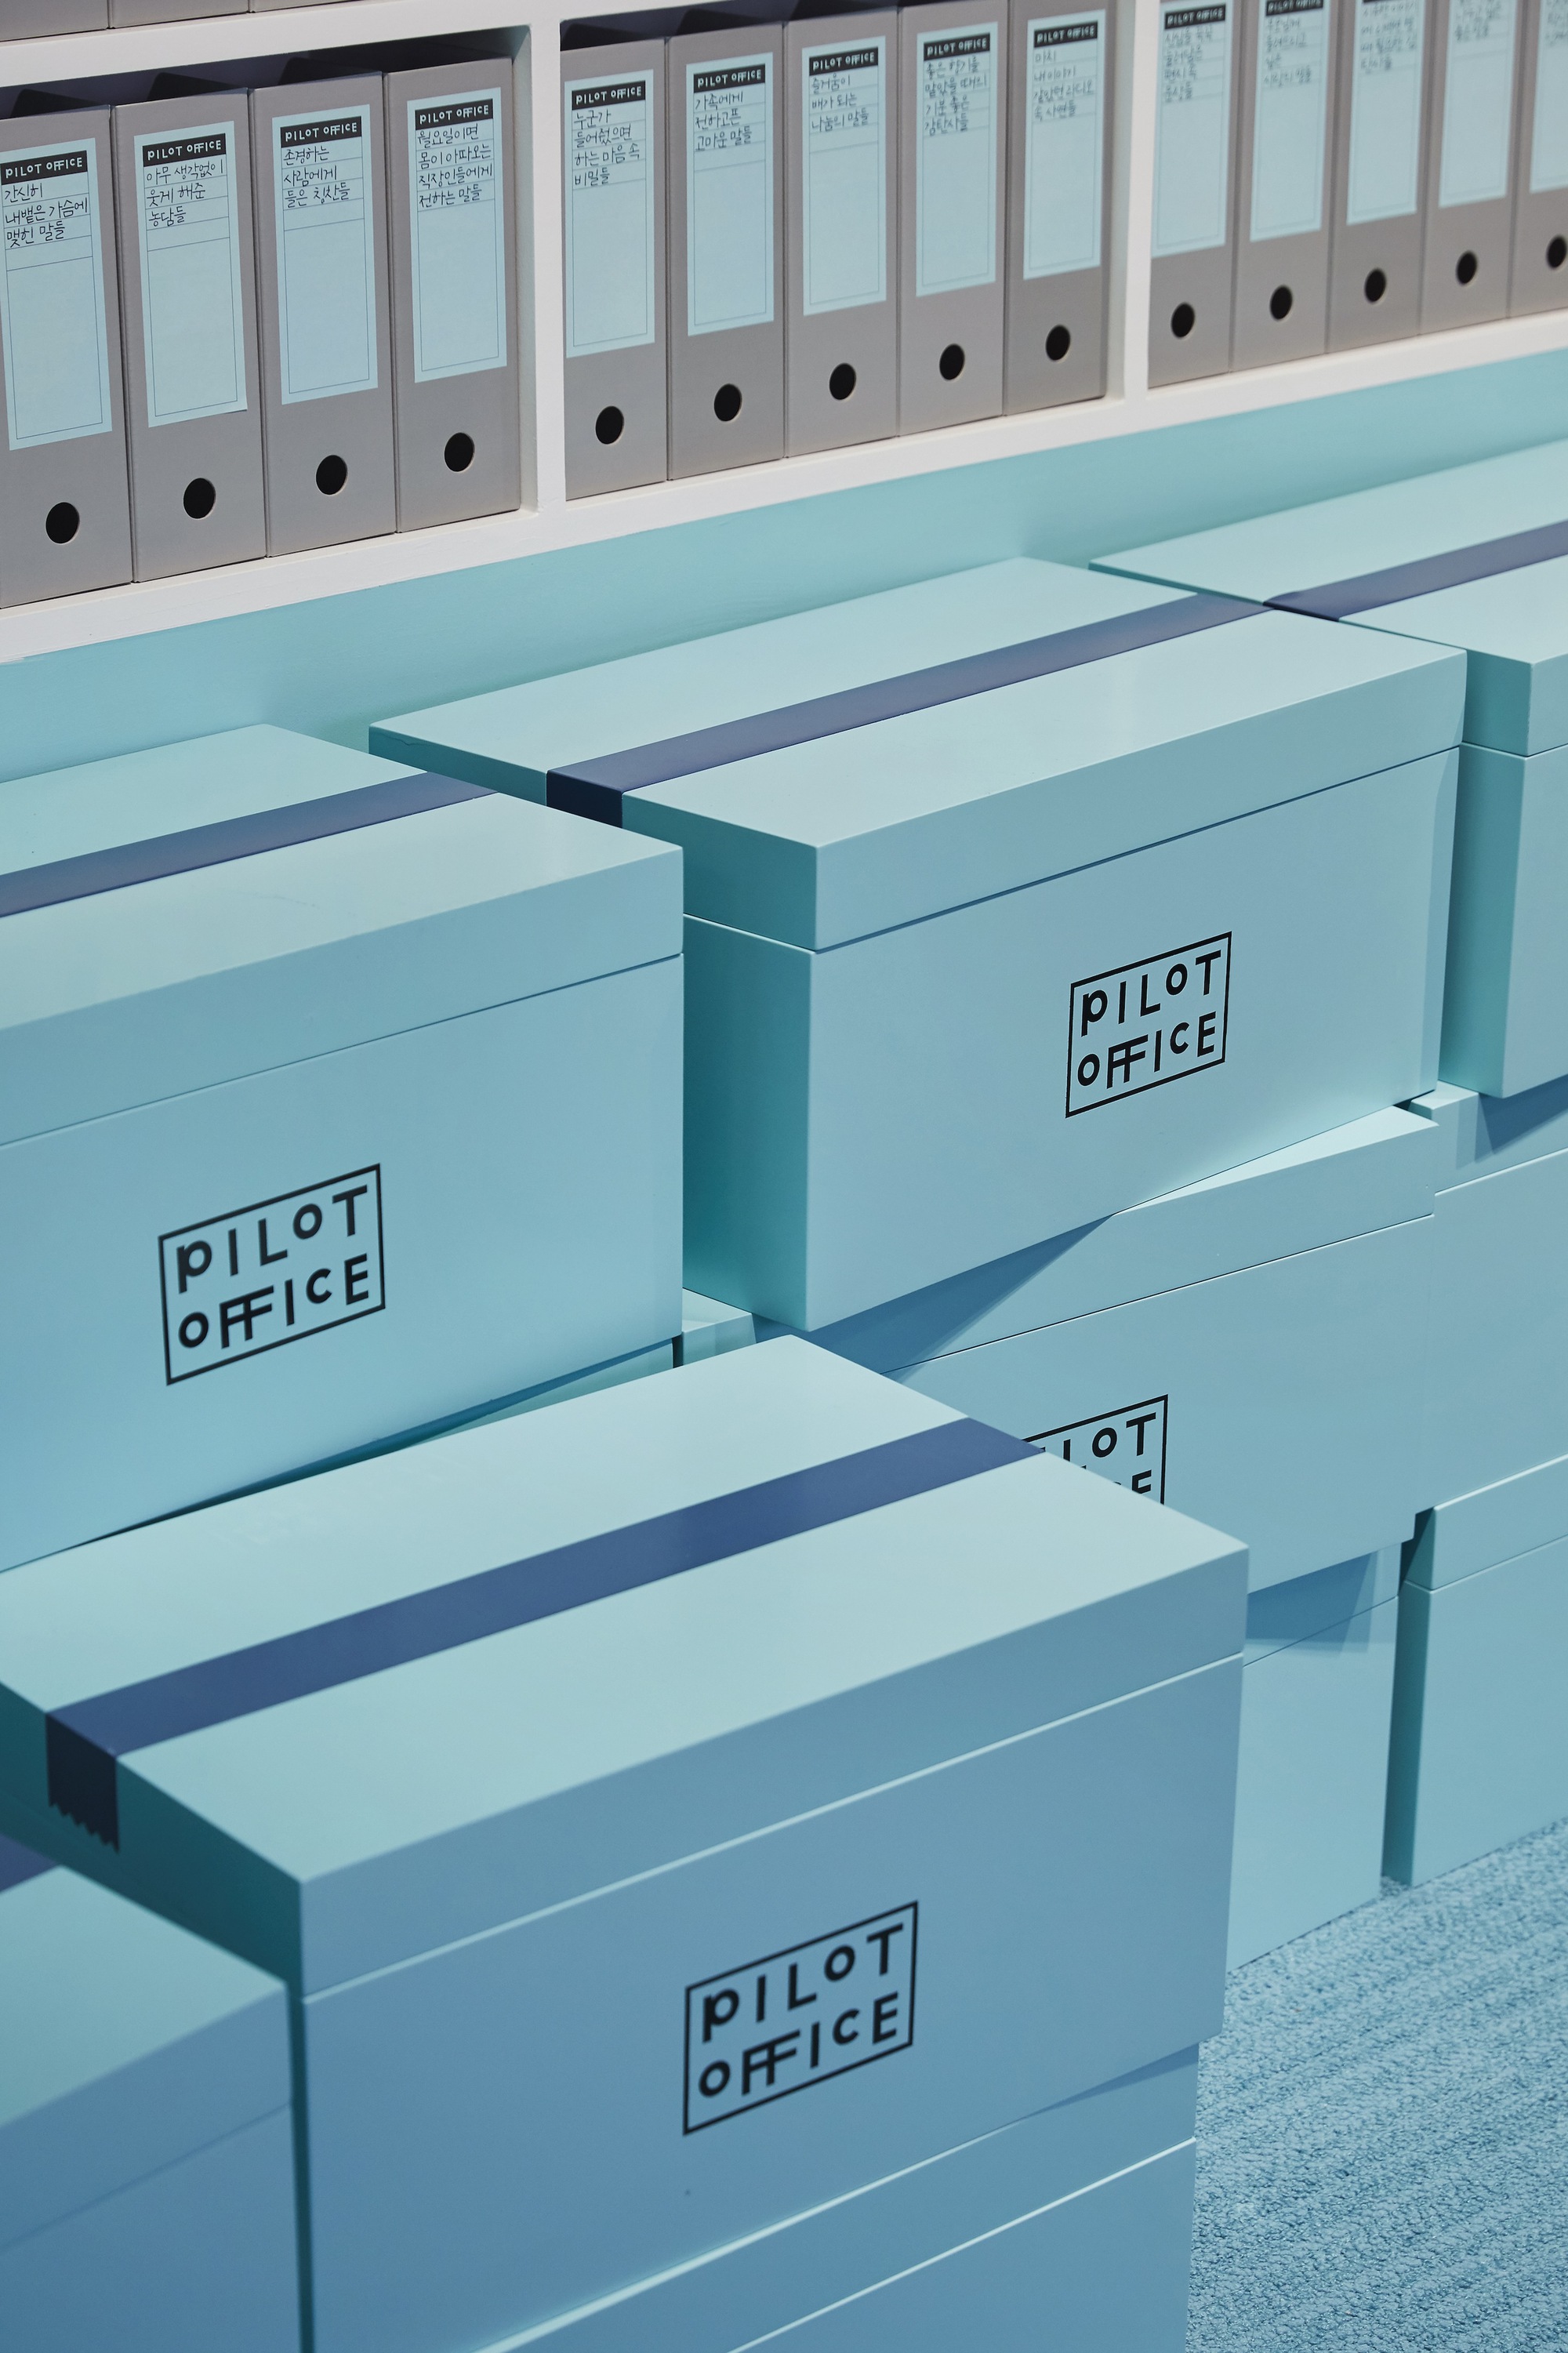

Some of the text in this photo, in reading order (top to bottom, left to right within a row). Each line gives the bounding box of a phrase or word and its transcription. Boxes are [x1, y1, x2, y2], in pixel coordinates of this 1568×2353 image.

[845, 52, 875, 66] OFFICE
[926, 56, 980, 80] 좋은 향기를
[1035, 49, 1056, 64] 마치
[731, 69, 761, 83] OFFICE
[811, 72, 851, 95] 즐거움이
[611, 86, 642, 100] OFFICE
[695, 91, 743, 111] 가족에게
[811, 92, 858, 110] 배가 되는
[456, 105, 489, 118] OFFICE
[926, 94, 969, 117] 기분 좋은
[323, 122, 357, 136] OFFICE
[574, 108, 612, 130] 누군가
[695, 108, 742, 130] 전하고픈
[811, 107, 869, 132] 나눔의 말들
[925, 112, 969, 136] 감탄사들
[187, 140, 222, 154] OFFICE
[417, 123, 478, 148] 월요일이면
[574, 123, 633, 148] 들어줬으면
[695, 125, 753, 151] 고마운 말들
[46, 158, 83, 171] OFFICE
[283, 146, 330, 165] 존경하는
[418, 143, 492, 170] 몸이 아파오는
[575, 143, 641, 167] 하는 마음 속
[147, 166, 171, 185] 아무
[284, 165, 337, 187] 사람에게
[419, 163, 492, 189] 직장인들에게
[575, 167, 610, 187] 비밀들
[5, 183, 42, 203] 간신히
[147, 183, 205, 207] 웃게 해준
[285, 182, 350, 209] 들은 칭찬들
[419, 183, 482, 208] 전하는 말들
[5, 197, 87, 225] 내뱉은 가슴에
[149, 205, 187, 227] 농담들
[7, 220, 66, 249] 맺힌 말들
[1081, 950, 1221, 1037] PILOT
[1077, 1011, 1216, 1089] OFFICE
[176, 1185, 368, 1294] PILOT
[178, 1253, 369, 1349] OFFICE
[702, 1923, 904, 2043] PILOT
[699, 1992, 898, 2097] OFFICE
